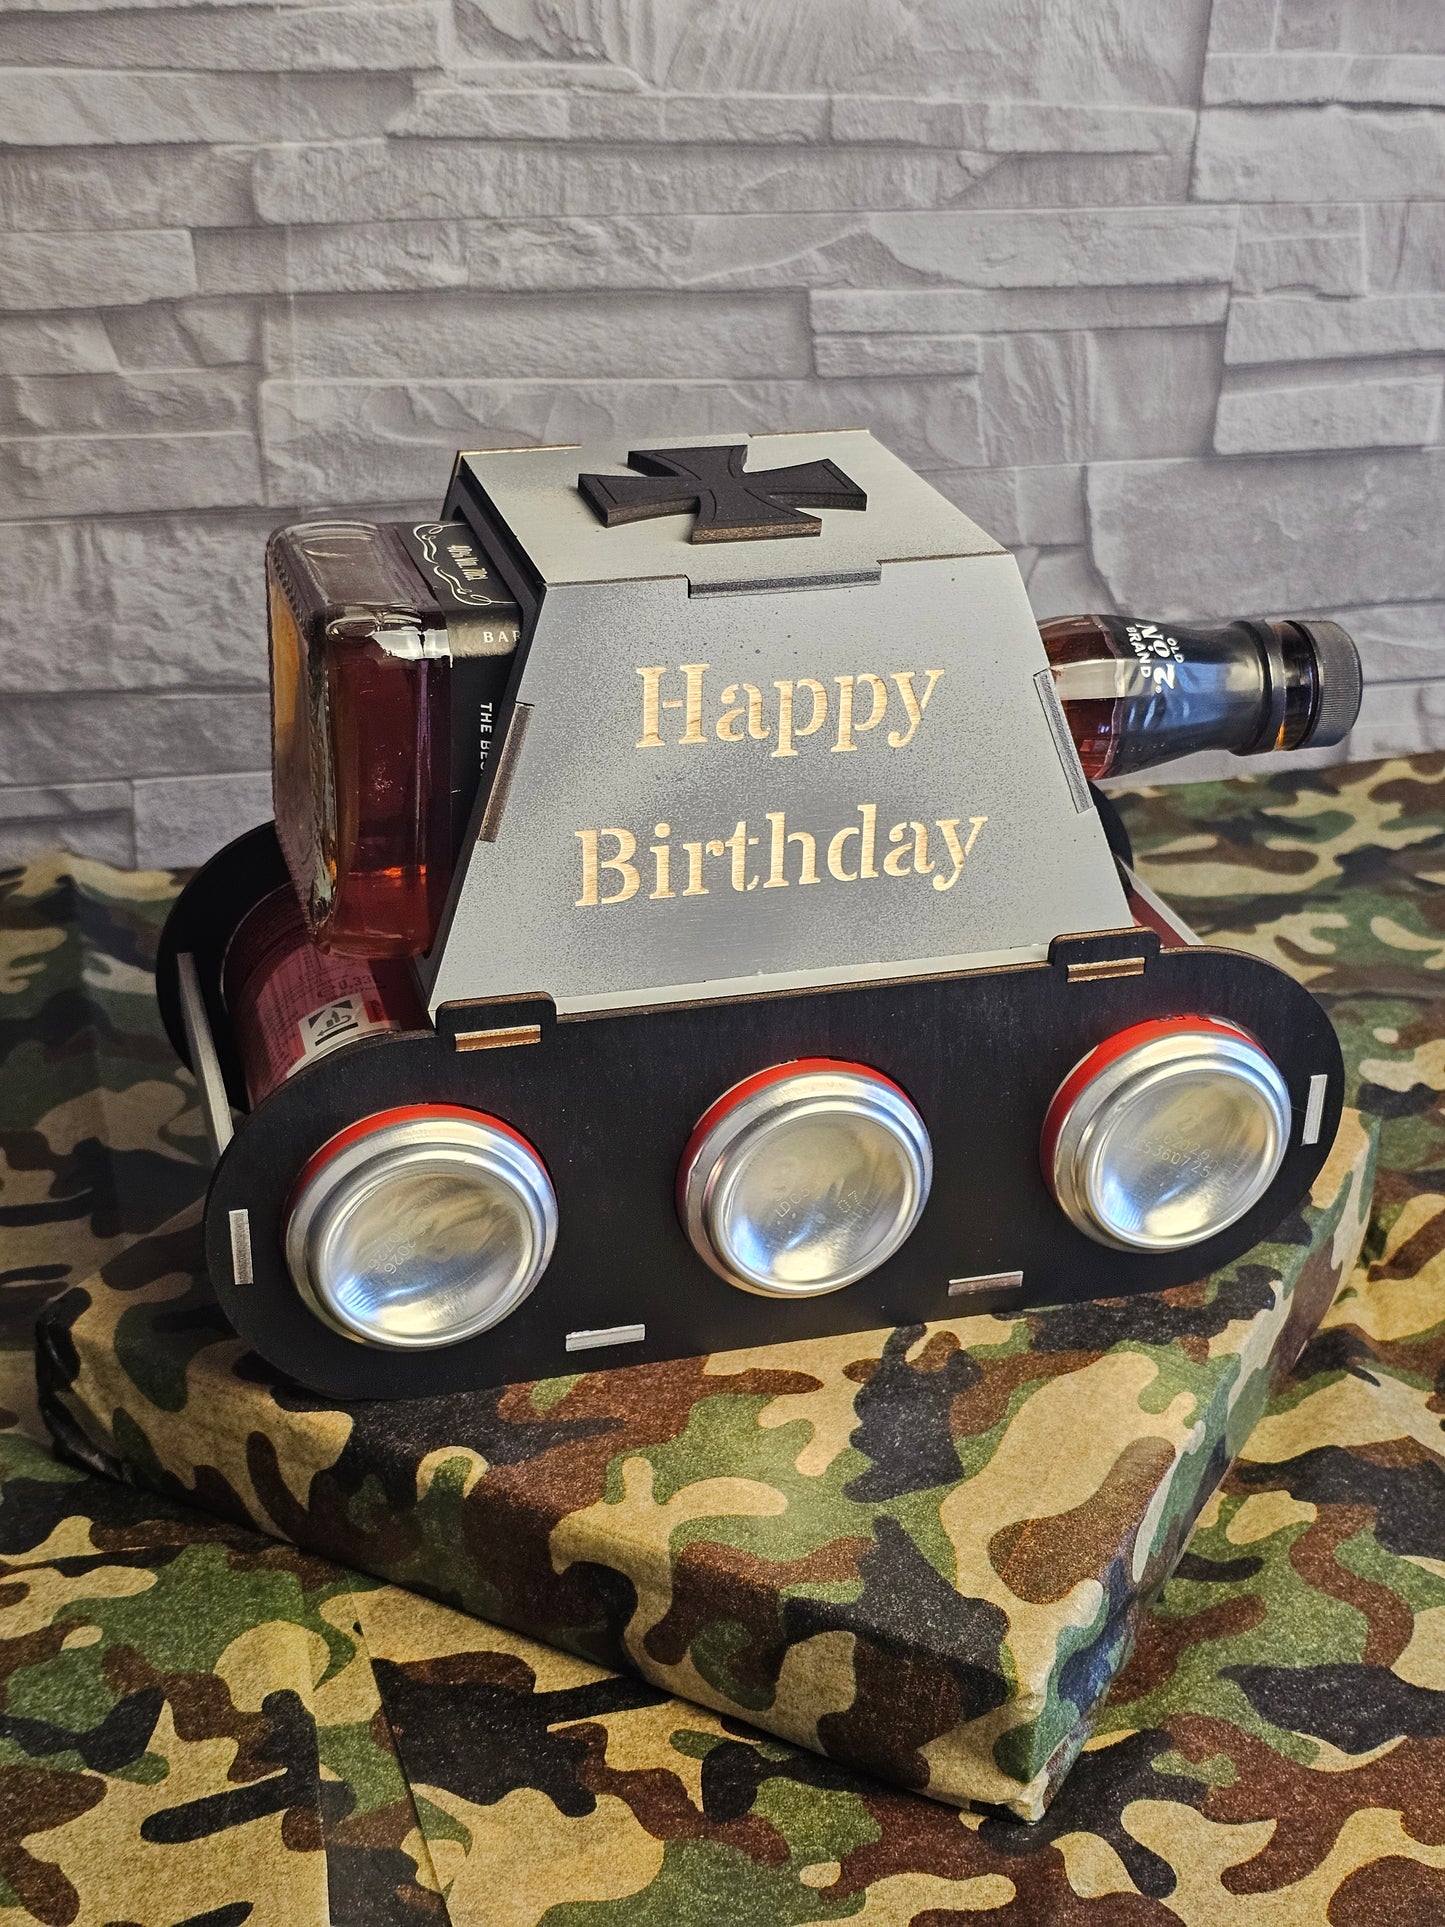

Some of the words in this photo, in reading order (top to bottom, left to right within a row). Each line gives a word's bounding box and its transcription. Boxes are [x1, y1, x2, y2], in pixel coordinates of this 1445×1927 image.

[1126, 626, 1152, 678] BRAND
[1167, 637, 1185, 664] OLD
[480, 702, 493, 733] THE
[635, 663, 945, 757] Happy
[574, 803, 989, 907] Birthday
